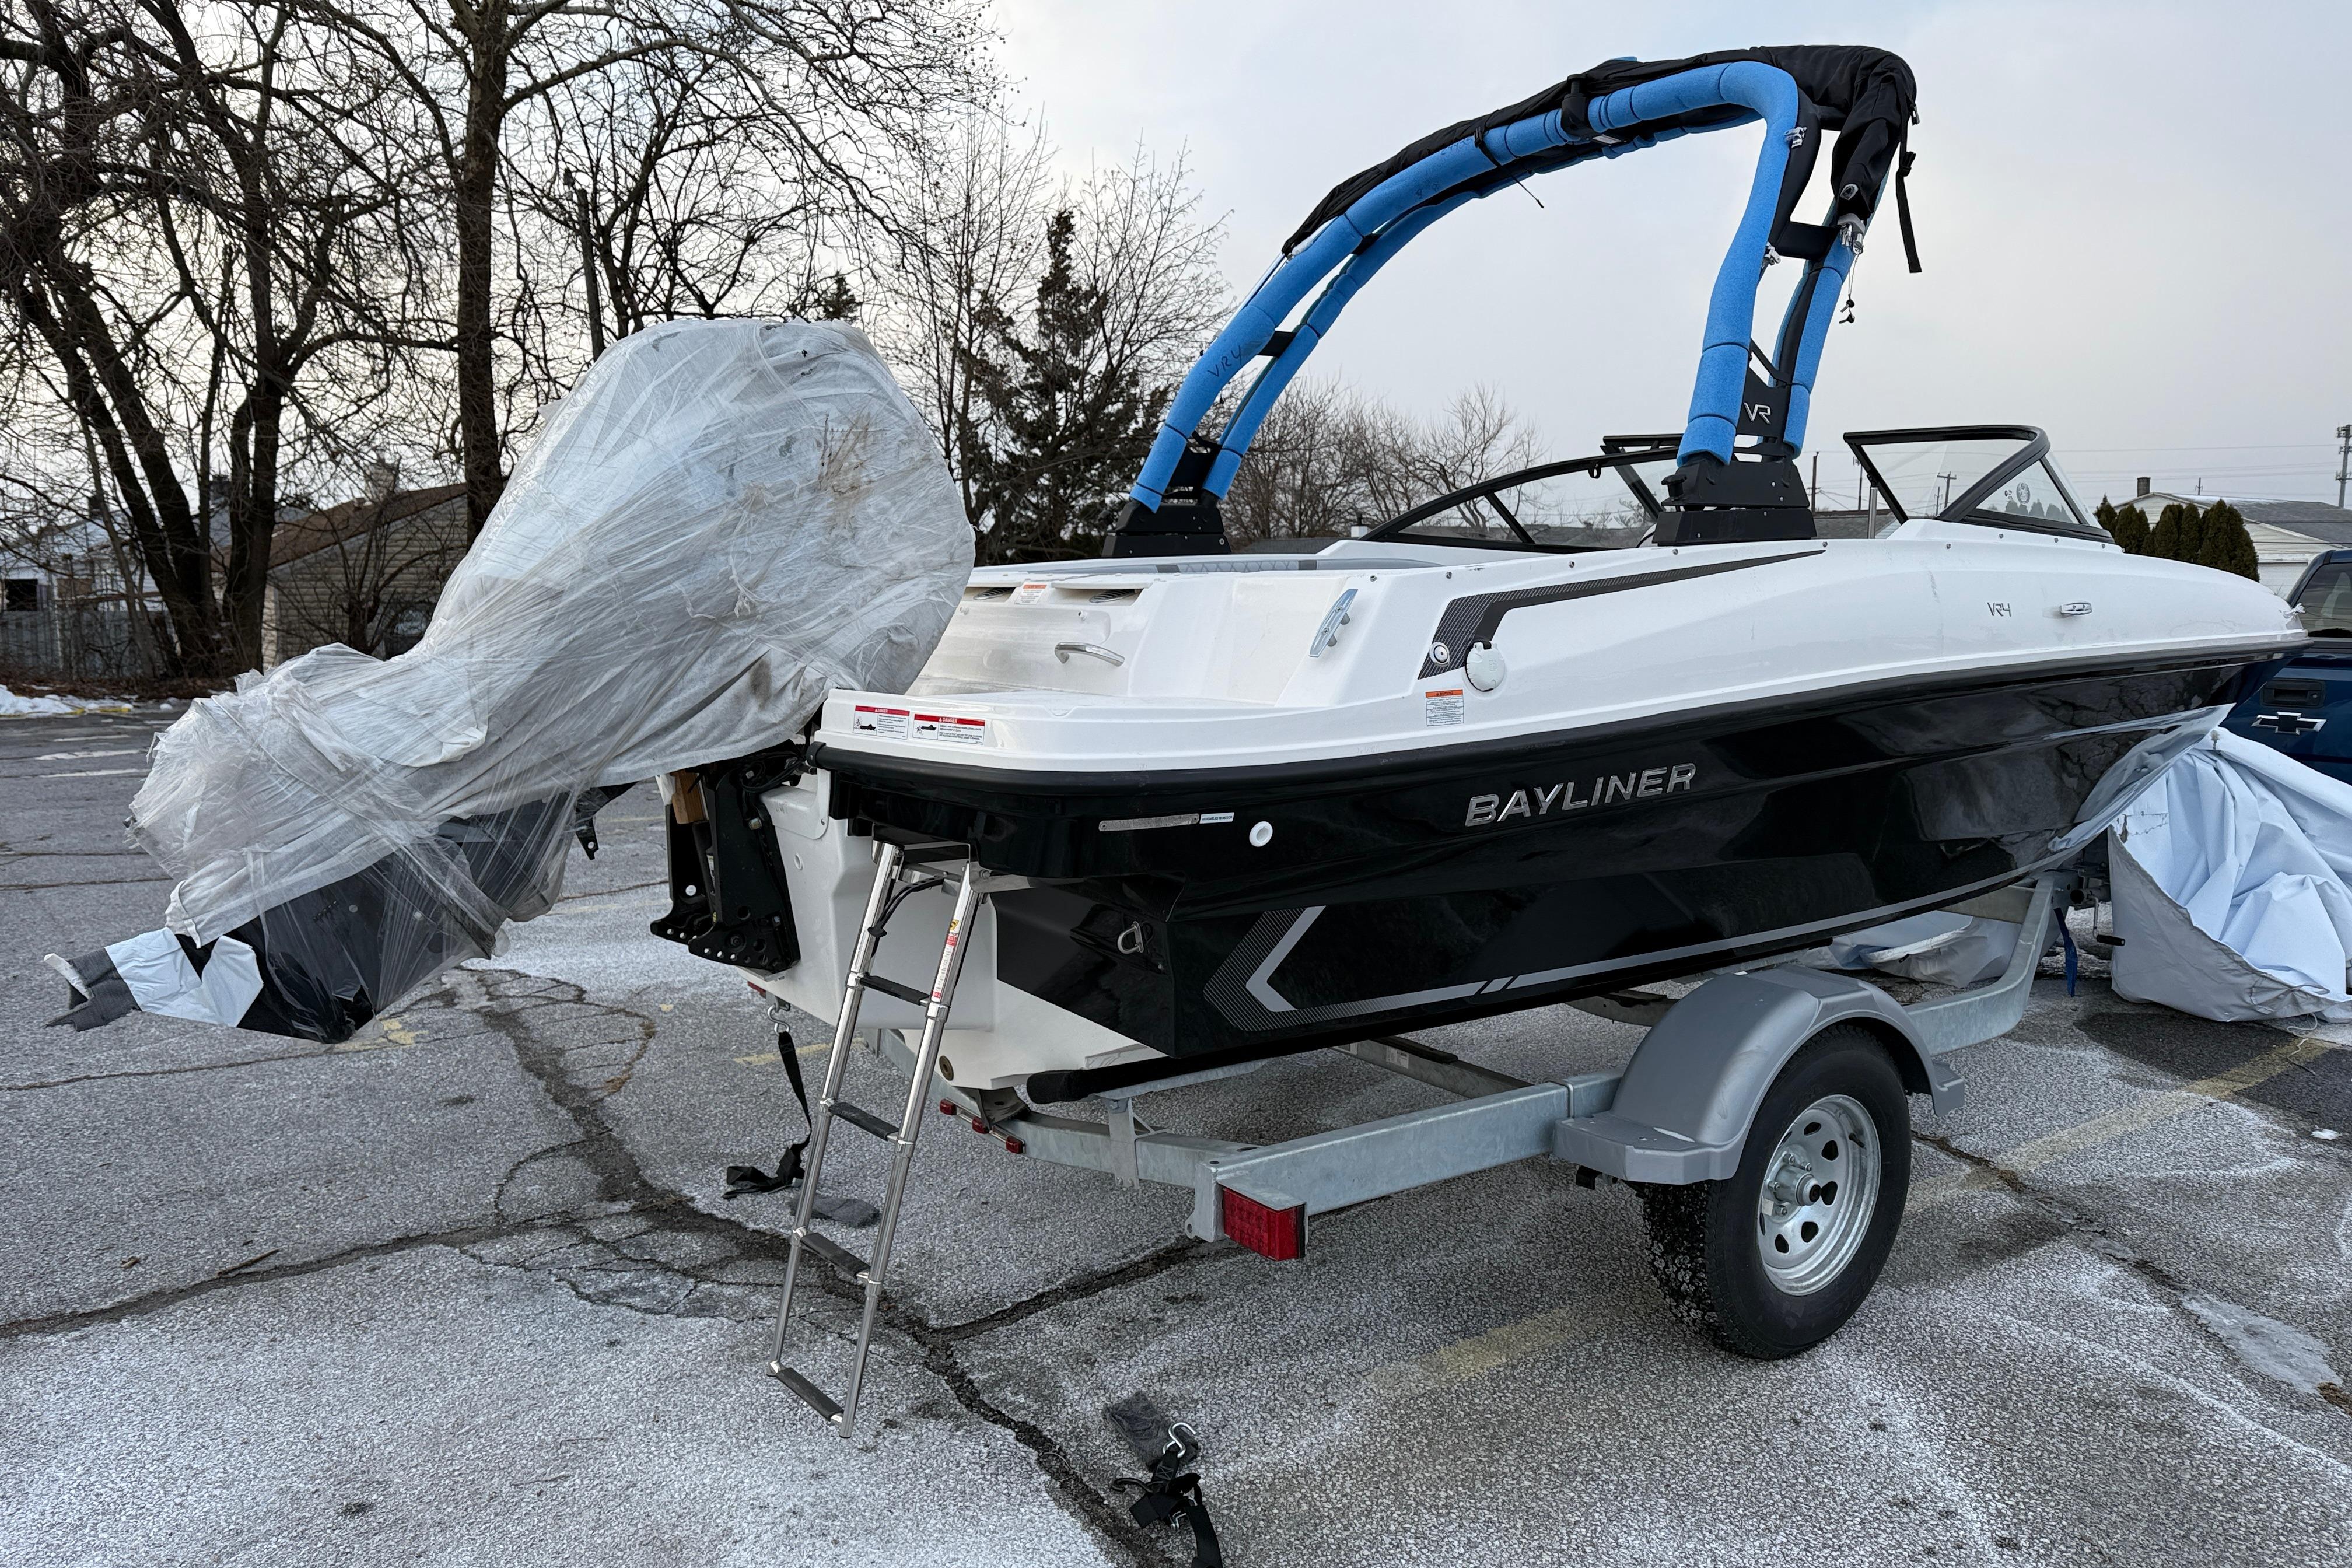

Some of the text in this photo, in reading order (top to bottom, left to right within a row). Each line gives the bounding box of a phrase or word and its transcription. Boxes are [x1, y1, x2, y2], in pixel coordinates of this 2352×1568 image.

[1743, 402, 1772, 425] VR
[1987, 601, 2012, 617] VR4
[1464, 762, 1697, 827] BAYLINER
